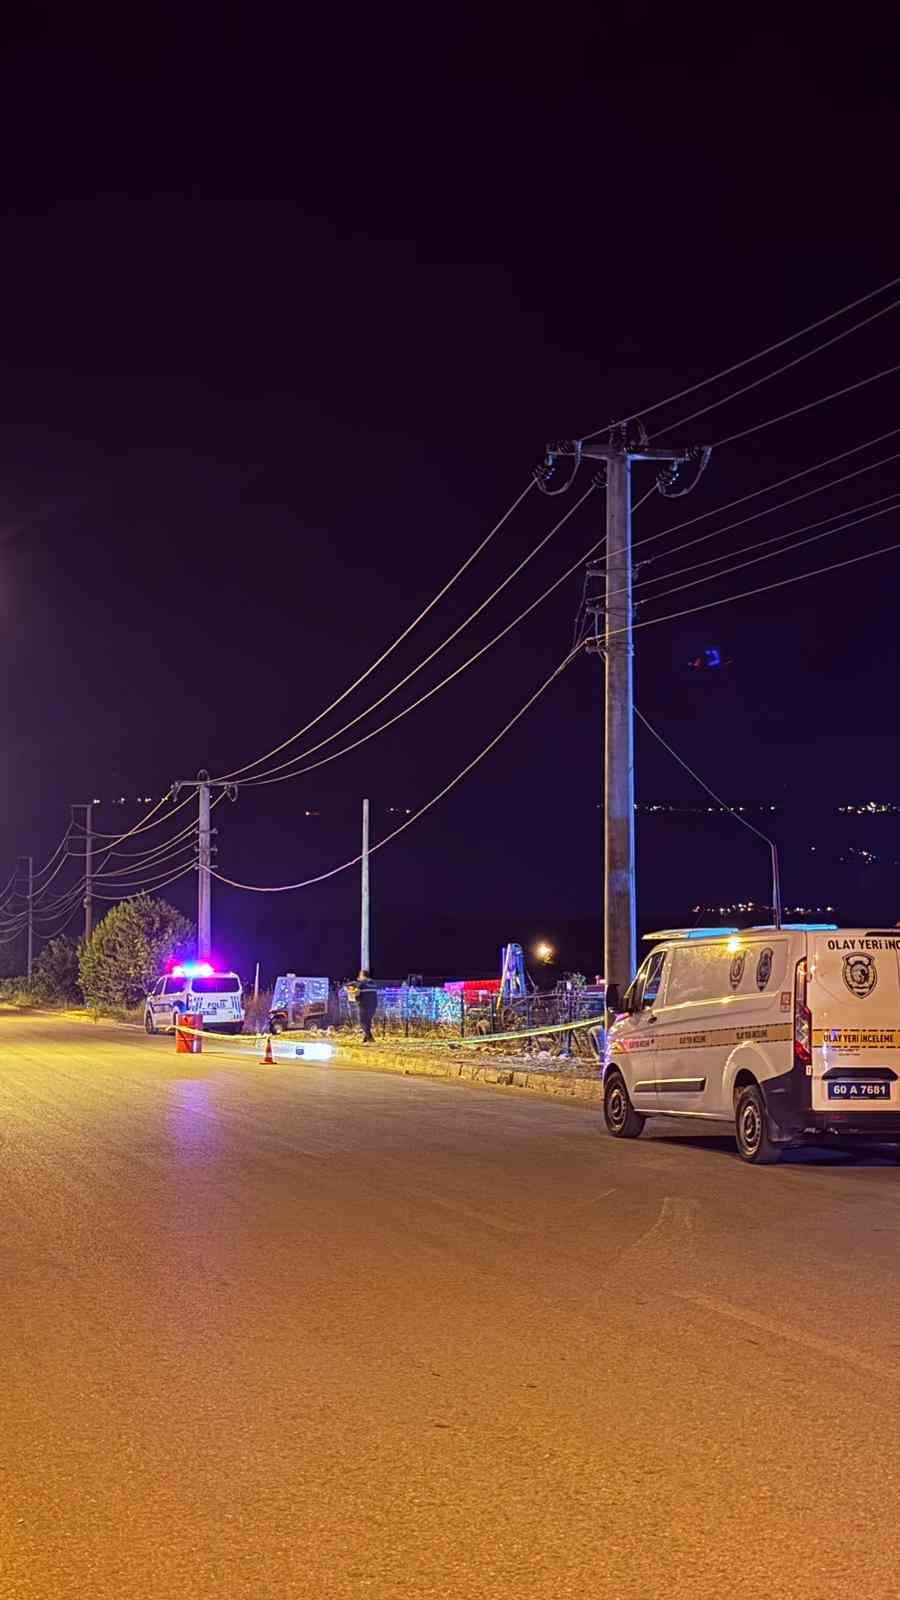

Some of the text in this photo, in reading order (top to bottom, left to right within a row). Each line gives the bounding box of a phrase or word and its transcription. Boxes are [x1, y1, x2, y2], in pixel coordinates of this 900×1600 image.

[827, 939, 856, 950] OLAY
[823, 1033, 842, 1043] OLAY
[833, 1085, 847, 1095] 60
[849, 1085, 858, 1095] A
